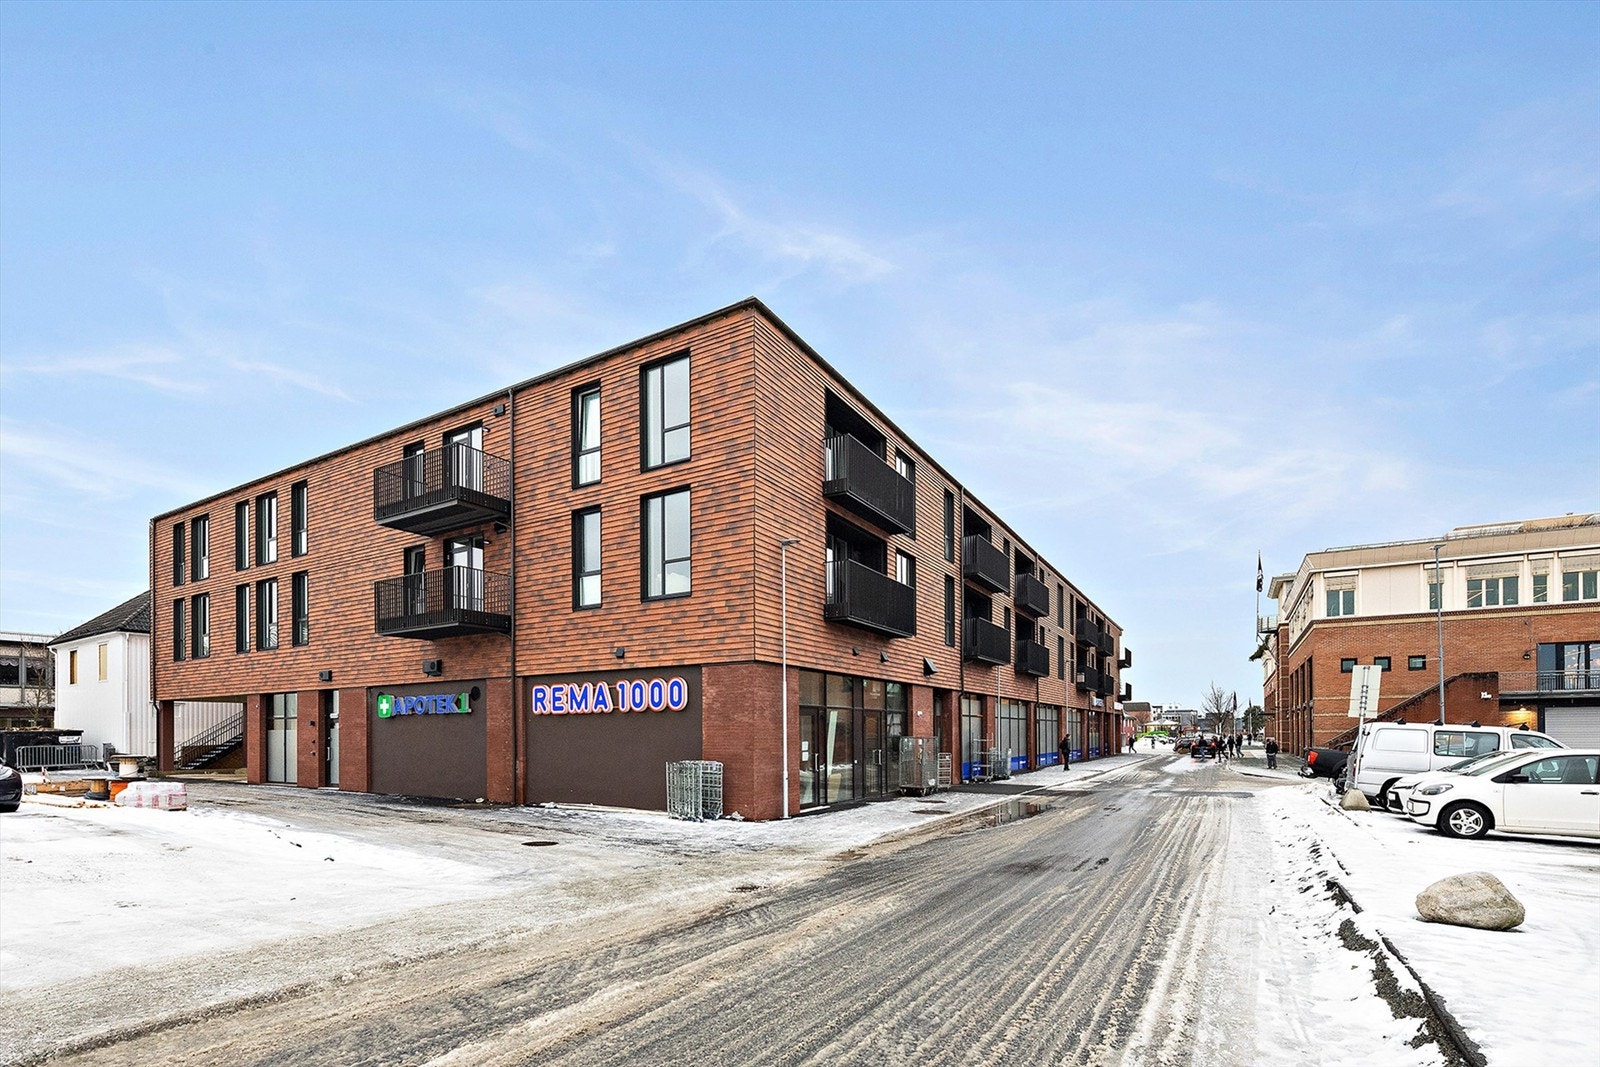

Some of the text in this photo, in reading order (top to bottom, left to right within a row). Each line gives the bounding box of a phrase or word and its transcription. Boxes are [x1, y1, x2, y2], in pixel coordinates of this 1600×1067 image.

[393, 692, 471, 715] APOTEK 1
[532, 677, 688, 714] REMA 1000
